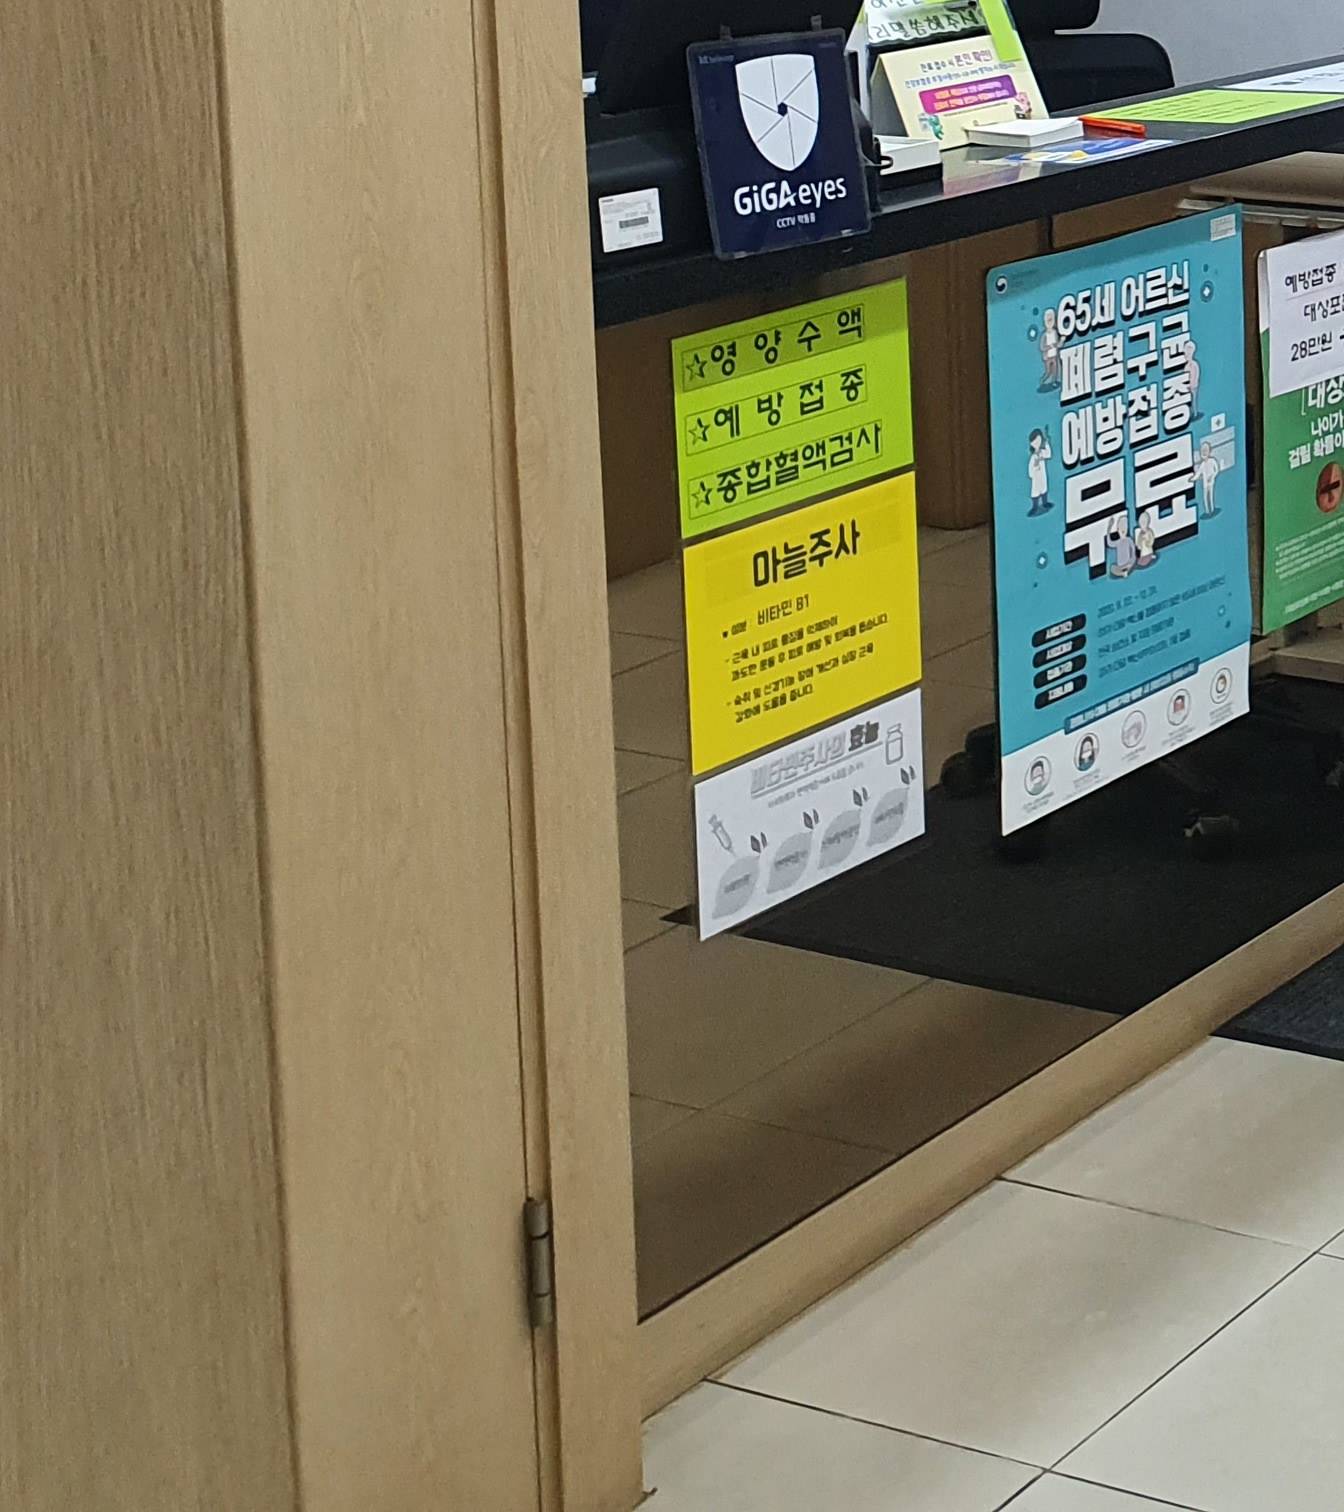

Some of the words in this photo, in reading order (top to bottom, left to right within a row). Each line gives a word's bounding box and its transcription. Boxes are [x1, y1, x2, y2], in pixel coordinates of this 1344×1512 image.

[776, 215, 796, 229] CCTV
[1056, 280, 1116, 337] 65세
[1119, 260, 1190, 319] 어르신
[1284, 263, 1337, 293] 예방접종
[1059, 311, 1190, 405] 폐렴구균
[1291, 332, 1333, 362] 28만원
[1061, 373, 1193, 468] 예방접종
[1311, 409, 1344, 437] 나이가
[716, 423, 882, 504] 종합혈액검사
[1064, 433, 1199, 578] 무료
[753, 519, 861, 588] 마늘주사
[758, 599, 793, 625] 비타민
